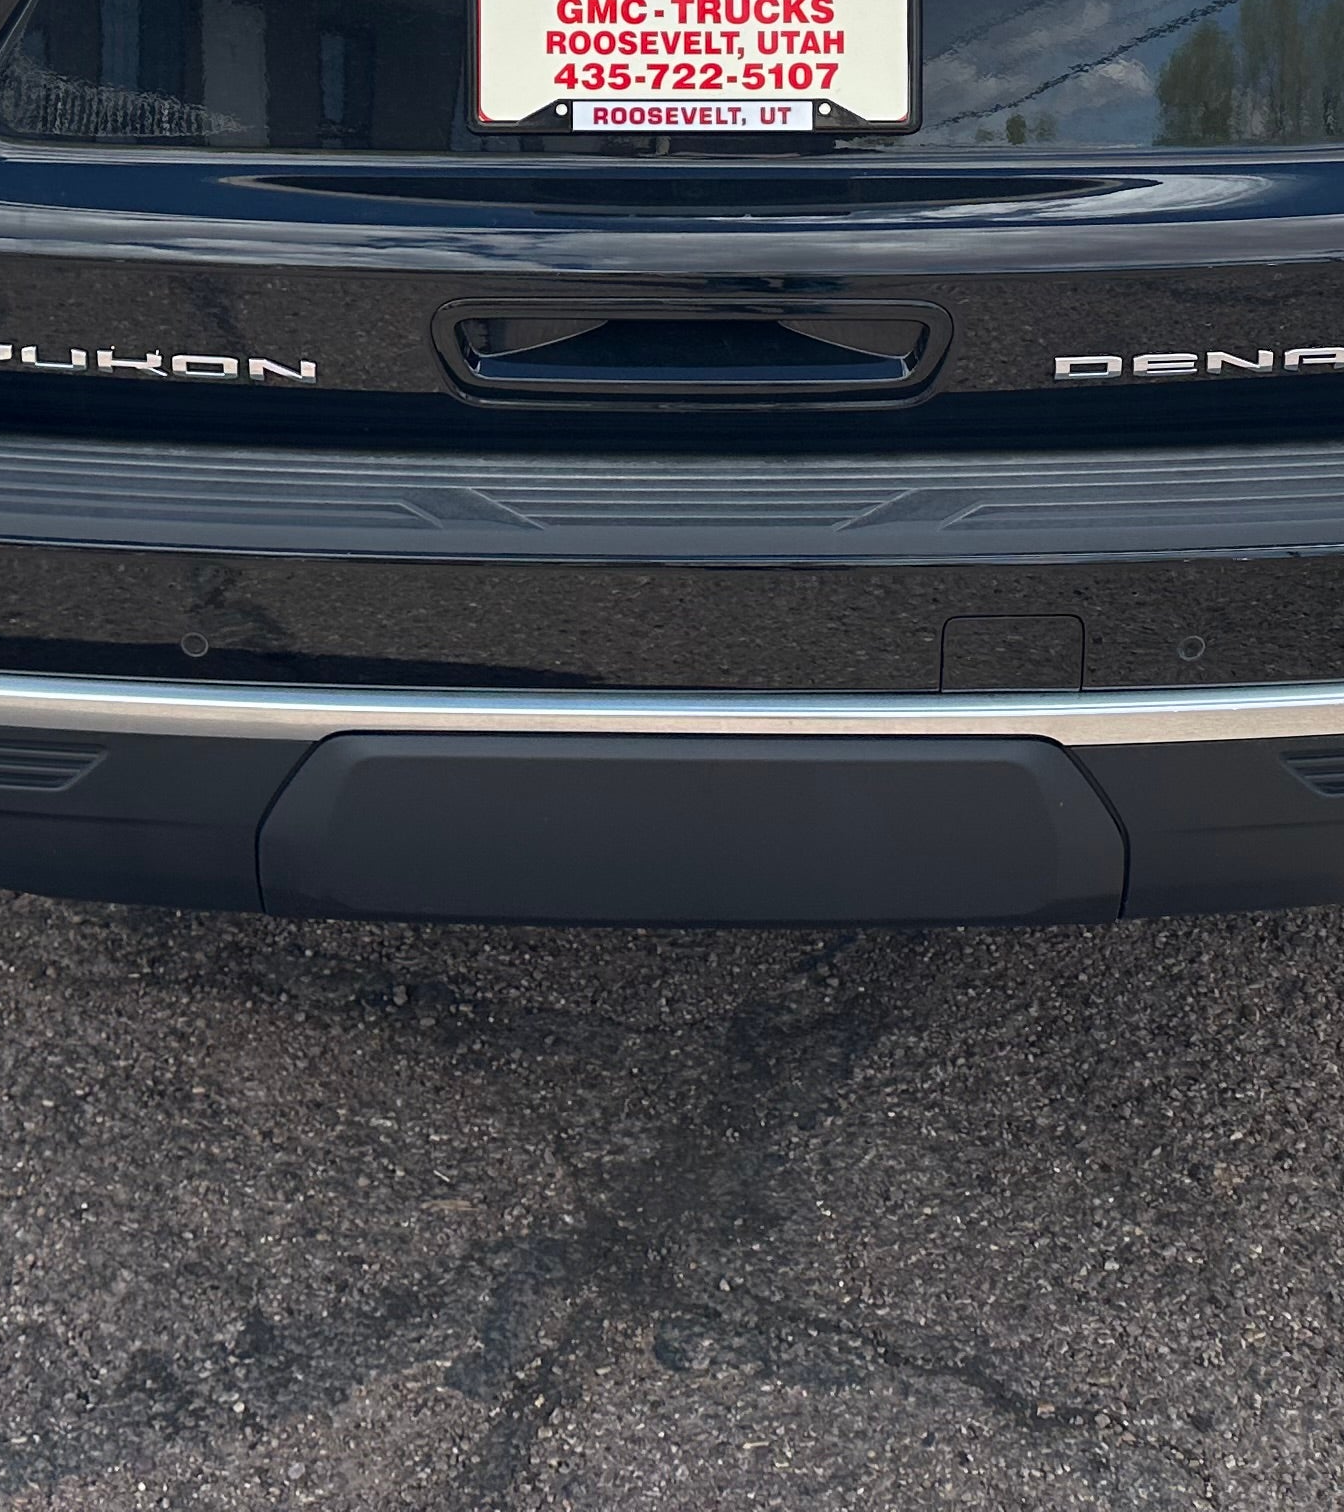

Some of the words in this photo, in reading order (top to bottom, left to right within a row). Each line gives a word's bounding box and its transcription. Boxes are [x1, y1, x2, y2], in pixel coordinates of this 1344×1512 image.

[546, 30, 746, 60] ROOSEVELT,
[757, 30, 845, 55] UTAH
[553, 62, 839, 90] 435-722-5107
[592, 106, 747, 127] ROOSEVELT,
[759, 106, 792, 125] UT
